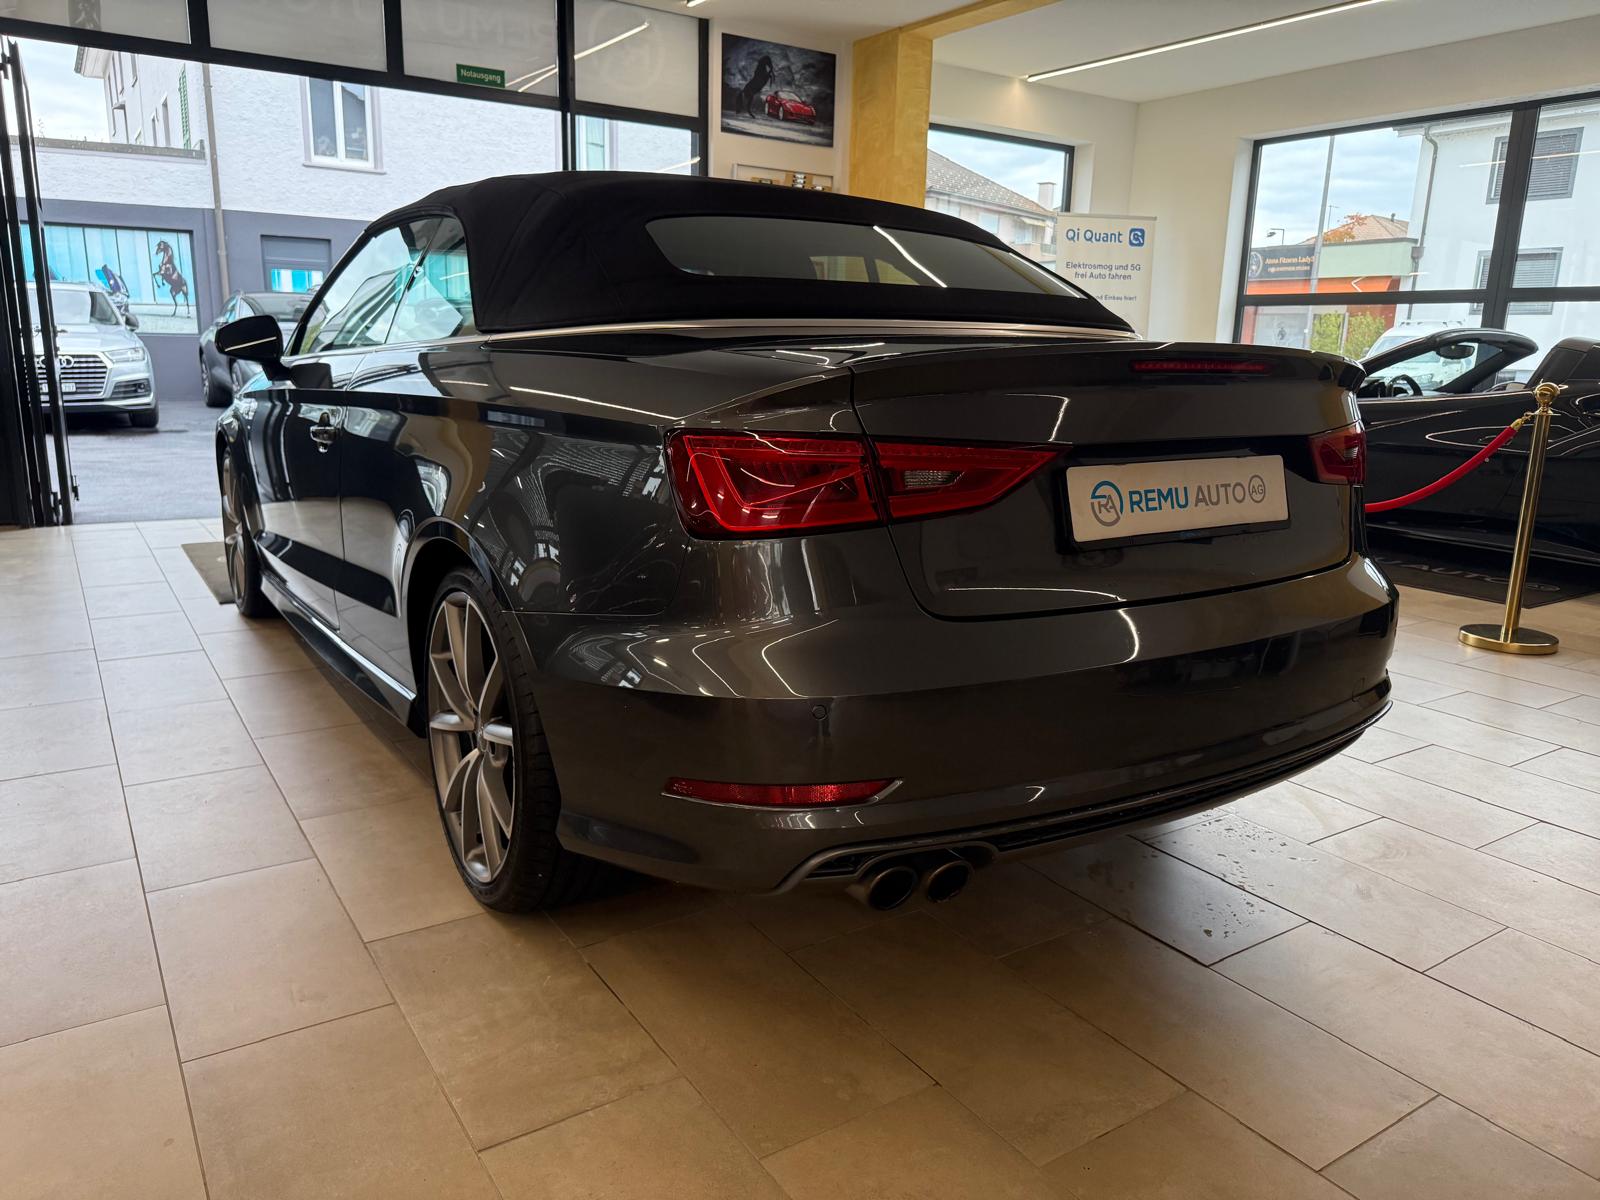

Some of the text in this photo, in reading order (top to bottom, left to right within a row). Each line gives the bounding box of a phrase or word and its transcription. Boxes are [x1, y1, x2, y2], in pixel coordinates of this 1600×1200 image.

[460, 68, 501, 84] Notausgang
[1065, 228, 1123, 243] Qi Quant
[1065, 261, 1141, 271] Elektrosmog und 5G
[1074, 272, 1087, 280] frei
[1089, 272, 1107, 280] Auto
[1128, 486, 1189, 513] REMU
[1194, 482, 1246, 508] AUTO
